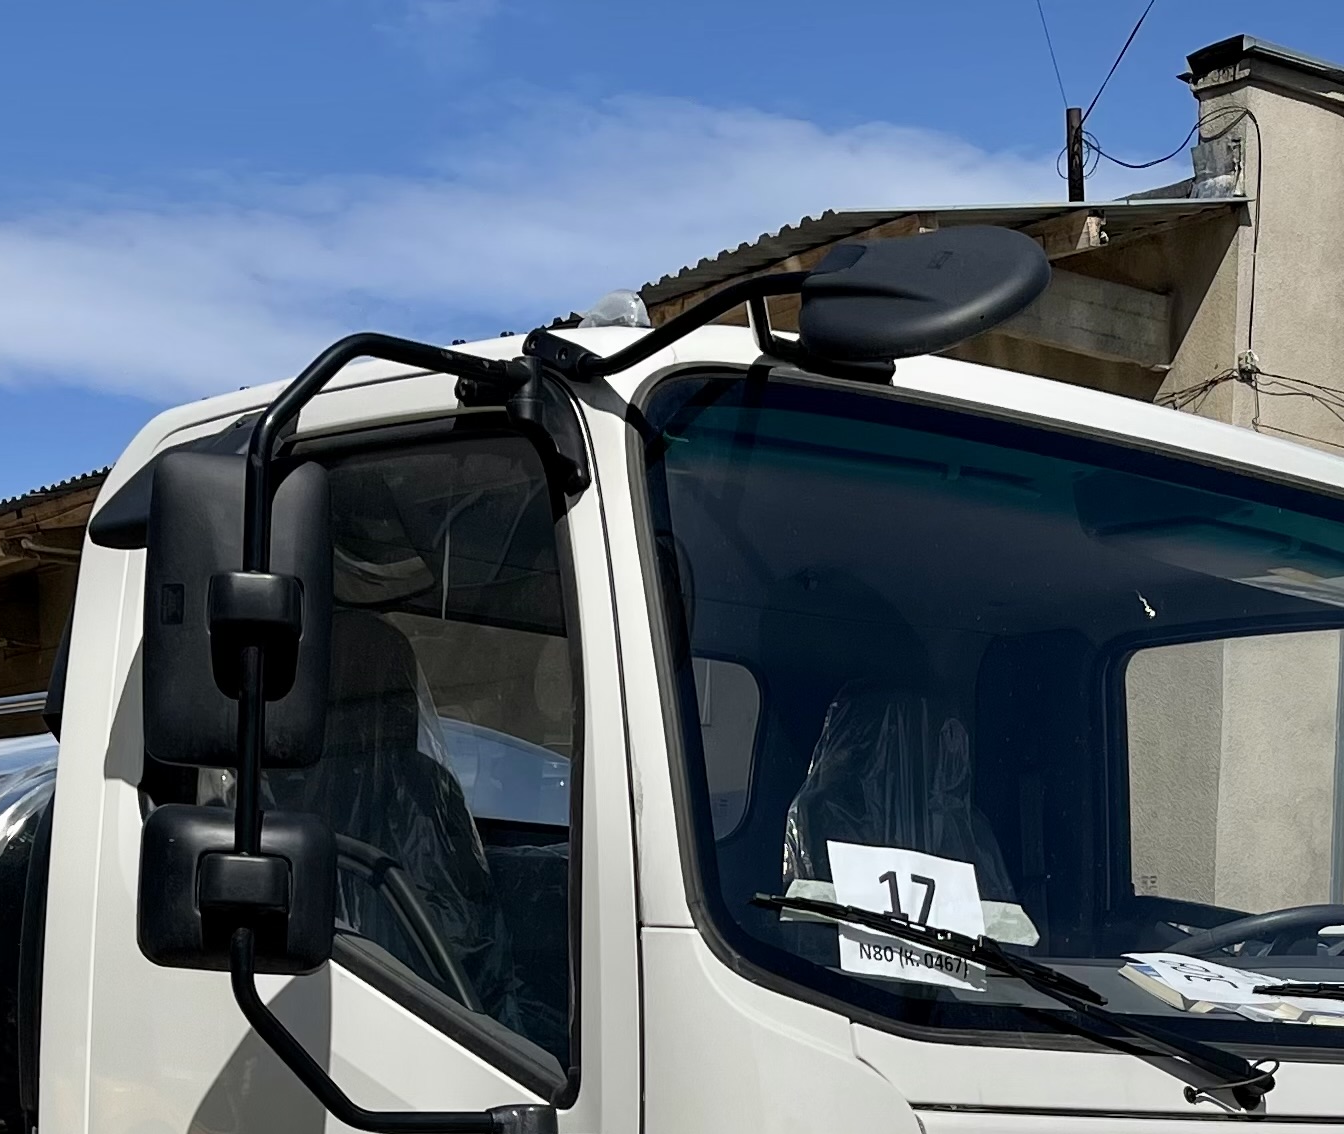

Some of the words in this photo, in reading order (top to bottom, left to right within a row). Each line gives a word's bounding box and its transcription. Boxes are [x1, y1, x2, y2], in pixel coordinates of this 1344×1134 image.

[878, 871, 936, 926] 17
[859, 943, 895, 963] N80
[924, 952, 969, 979] 0467)
